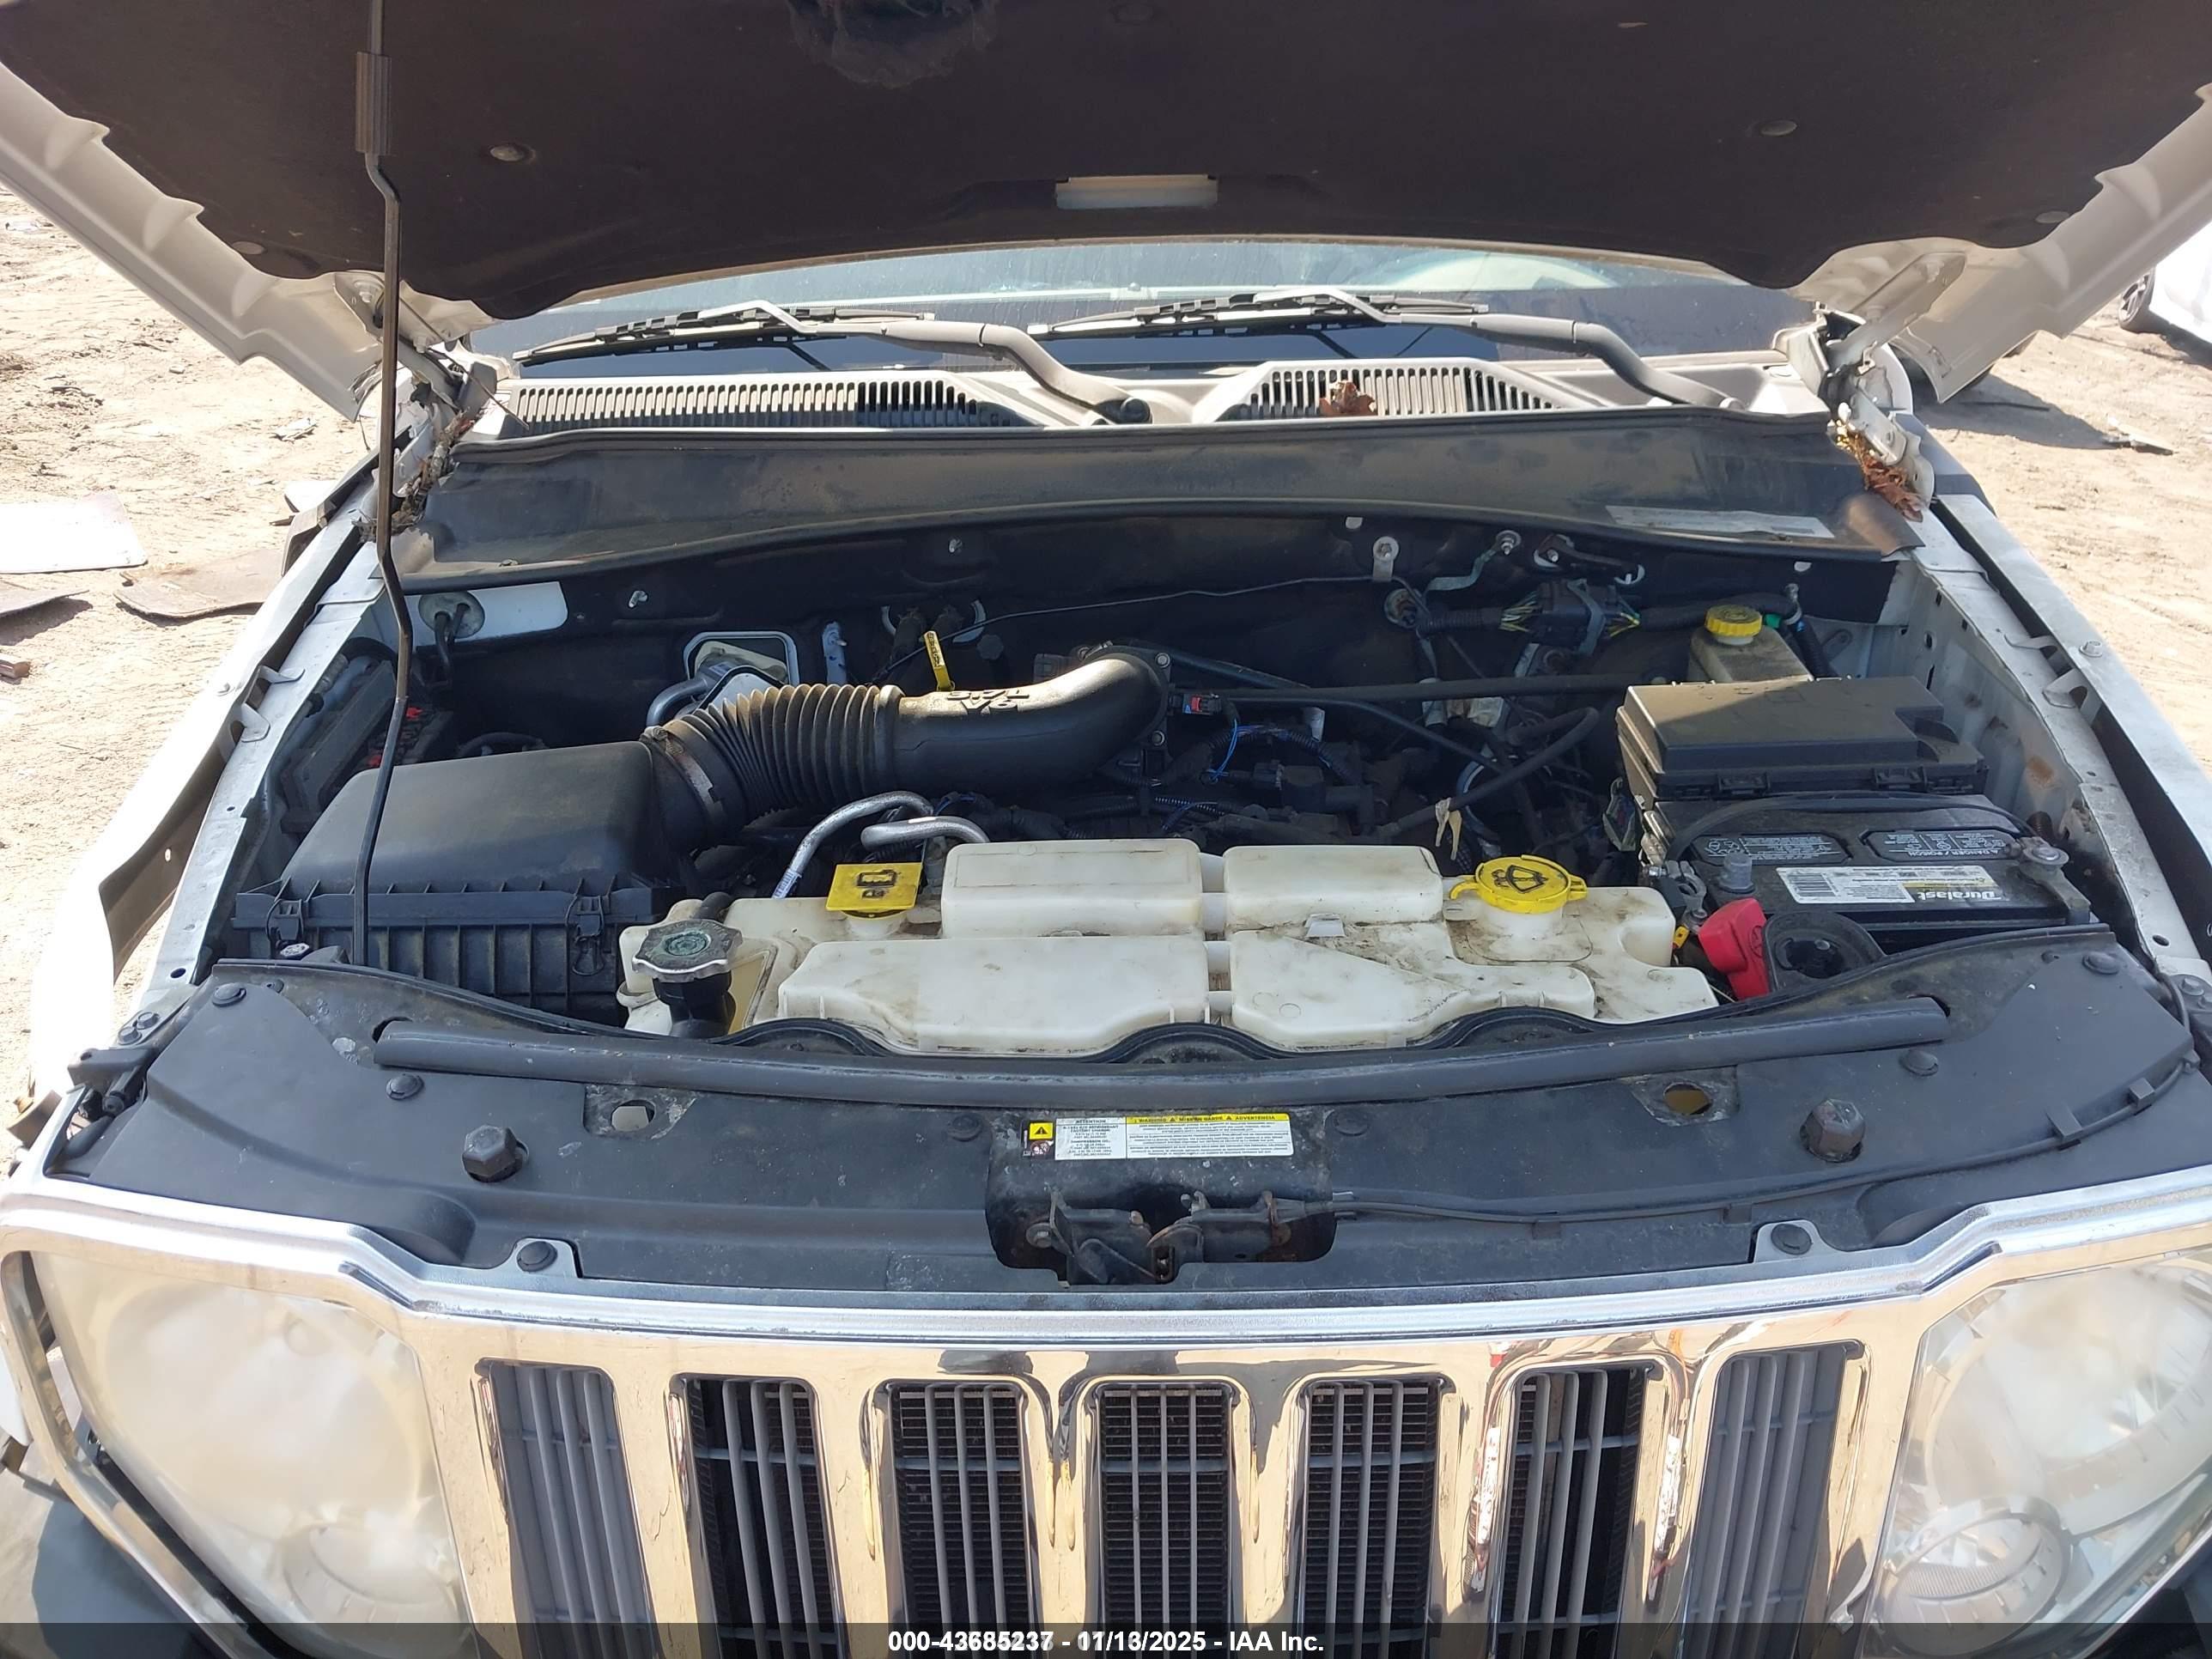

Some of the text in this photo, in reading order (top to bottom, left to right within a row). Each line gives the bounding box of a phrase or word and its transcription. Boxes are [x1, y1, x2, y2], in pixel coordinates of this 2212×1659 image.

[947, 689, 1030, 700] 3.7L
[961, 698, 1018, 714] V6
[1917, 890, 2002, 901] Duralast
